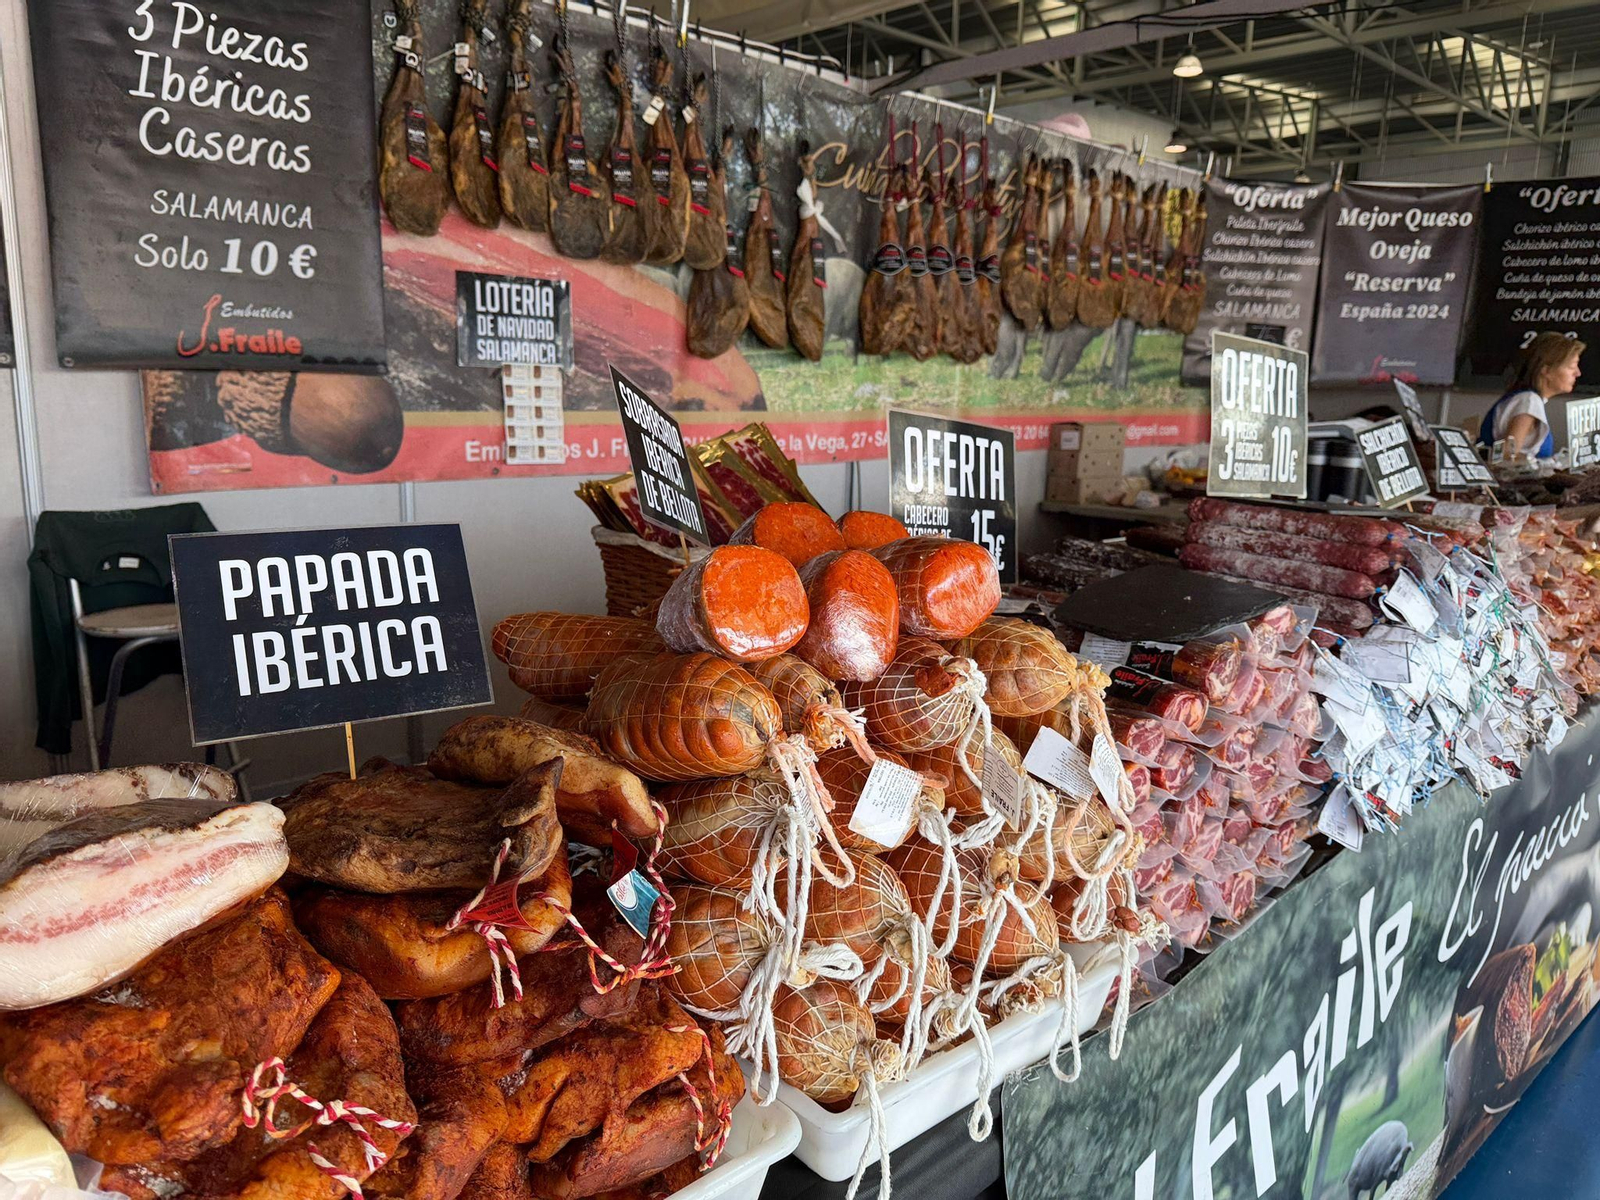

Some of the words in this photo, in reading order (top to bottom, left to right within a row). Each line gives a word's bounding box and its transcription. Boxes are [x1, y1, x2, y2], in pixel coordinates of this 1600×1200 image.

[128, 0, 155, 41] 3
[172, 2, 309, 71] Piezas
[129, 50, 311, 122] Ibéricas
[139, 107, 311, 173] Caseras
[151, 190, 313, 229] SALAMANCA
[1336, 206, 1402, 231] Mejor
[1405, 208, 1473, 232] Queso
[1513, 223, 1552, 235] Chorizo
[134, 233, 209, 271] Solo
[220, 238, 279, 276] 10
[288, 244, 318, 279] €
[1369, 239, 1432, 264] Oveja
[1549, 255, 1563, 266] de
[1344, 270, 1456, 293] “Reserva”
[1532, 271, 1544, 282] de
[220, 301, 294, 319] Embutidos
[474, 279, 555, 317] LOTERÍA
[1213, 300, 1301, 320] SALAMANCA
[1340, 302, 1403, 323] España
[1405, 304, 1450, 320] 2024
[1511, 308, 1600, 322] SALAMANCA
[476, 315, 495, 336] DE
[497, 317, 555, 340] NAVIDAD
[476, 340, 556, 363] SALAMANCA
[1221, 348, 1299, 419] OFERTA
[618, 380, 685, 459] SOBRASADA
[789, 434, 803, 451] la
[805, 433, 849, 454] Vega,
[1218, 418, 1235, 481] 3
[904, 426, 1005, 501] OFERTA
[641, 469, 663, 512] DE
[659, 479, 703, 535] BELLOTA
[904, 503, 949, 527] CABECERO
[218, 548, 440, 621] PAPADA
[232, 615, 448, 696] IBÉRICA
[1437, 817, 1499, 963] El
[1192, 886, 1414, 1200] Fraile
